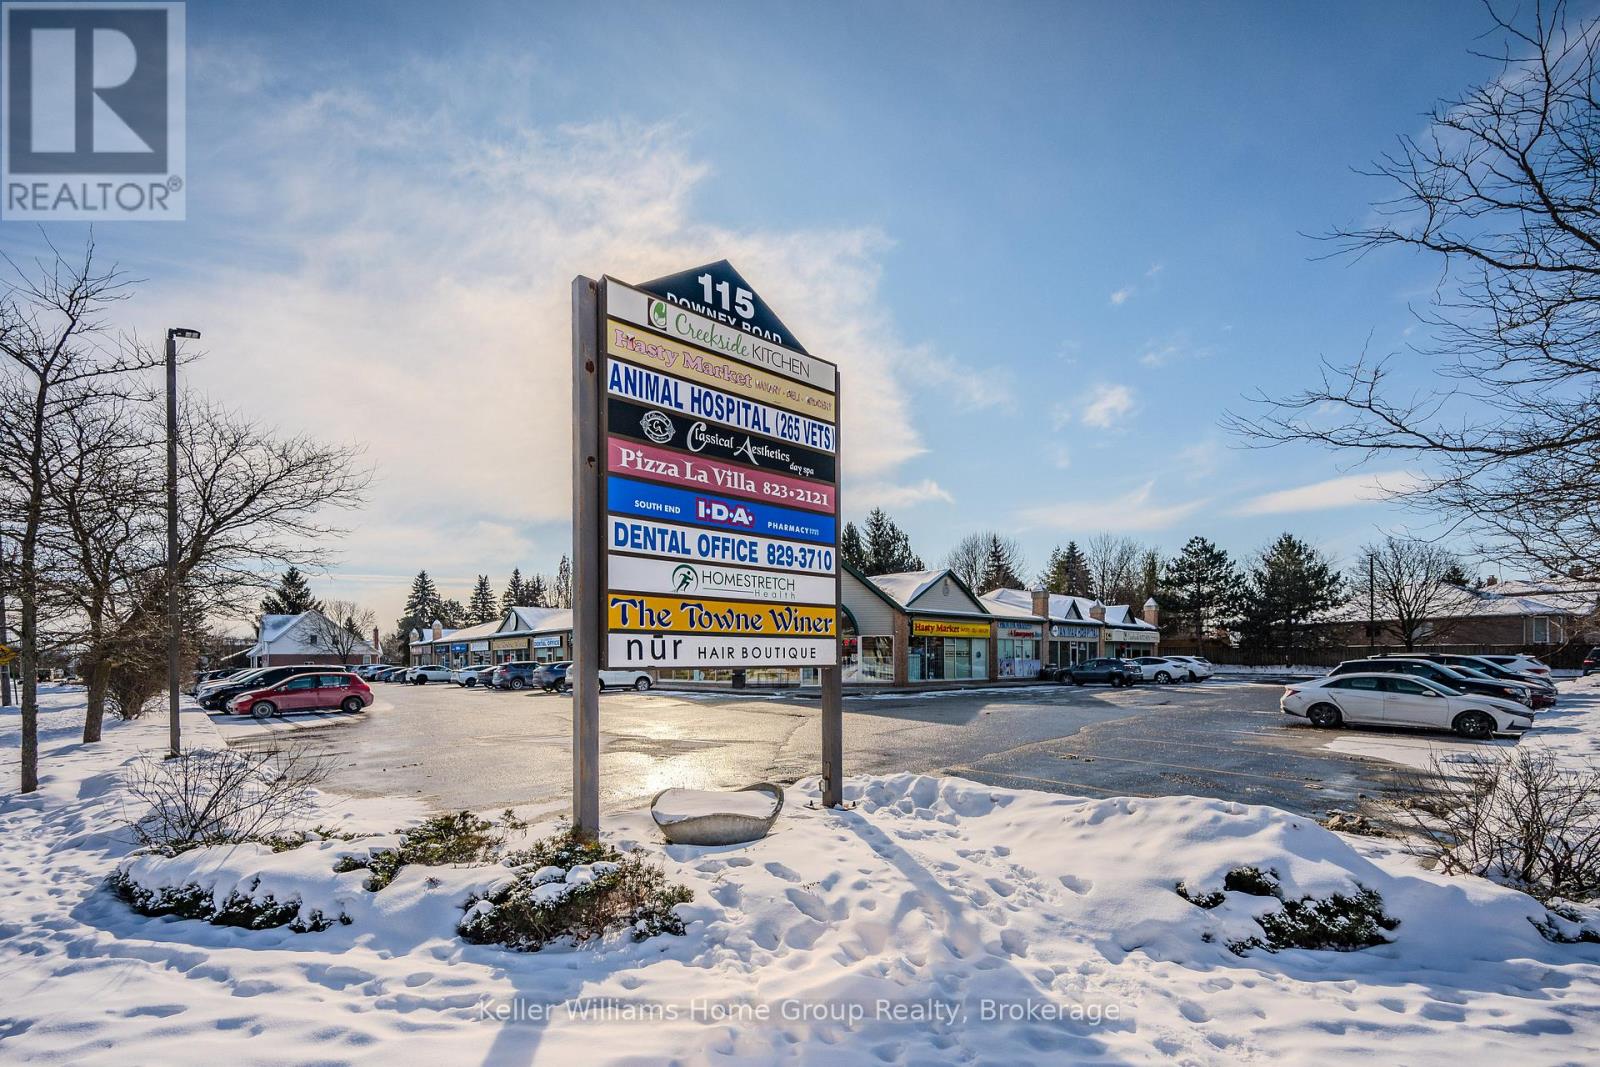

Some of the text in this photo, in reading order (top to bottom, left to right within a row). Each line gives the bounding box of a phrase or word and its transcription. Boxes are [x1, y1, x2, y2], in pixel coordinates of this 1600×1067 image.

[698, 272, 755, 319] 115
[614, 329, 679, 367] Hasty
[683, 351, 752, 388] Market
[676, 313, 810, 378] Creekside KITCHEN
[609, 363, 835, 450] ANIMAL HOSPITAL (265 VETS)
[686, 421, 790, 465] Classical Aesthetics
[619, 447, 680, 478] Pizza
[683, 460, 709, 484] La
[713, 468, 757, 493] Villa
[790, 462, 815, 476] day spa
[634, 500, 681, 514] SOUTH END
[767, 521, 810, 535] PHARMACY
[614, 522, 832, 571] DENTAL OFFICE 829-3710
[702, 570, 795, 592] HOMESTRETCH
[754, 589, 796, 600] Health
[610, 597, 833, 632] The Towne Winer
[936, 624, 960, 633] Market
[698, 646, 735, 660] HAIR
[742, 646, 816, 660] BOUTIQUE
